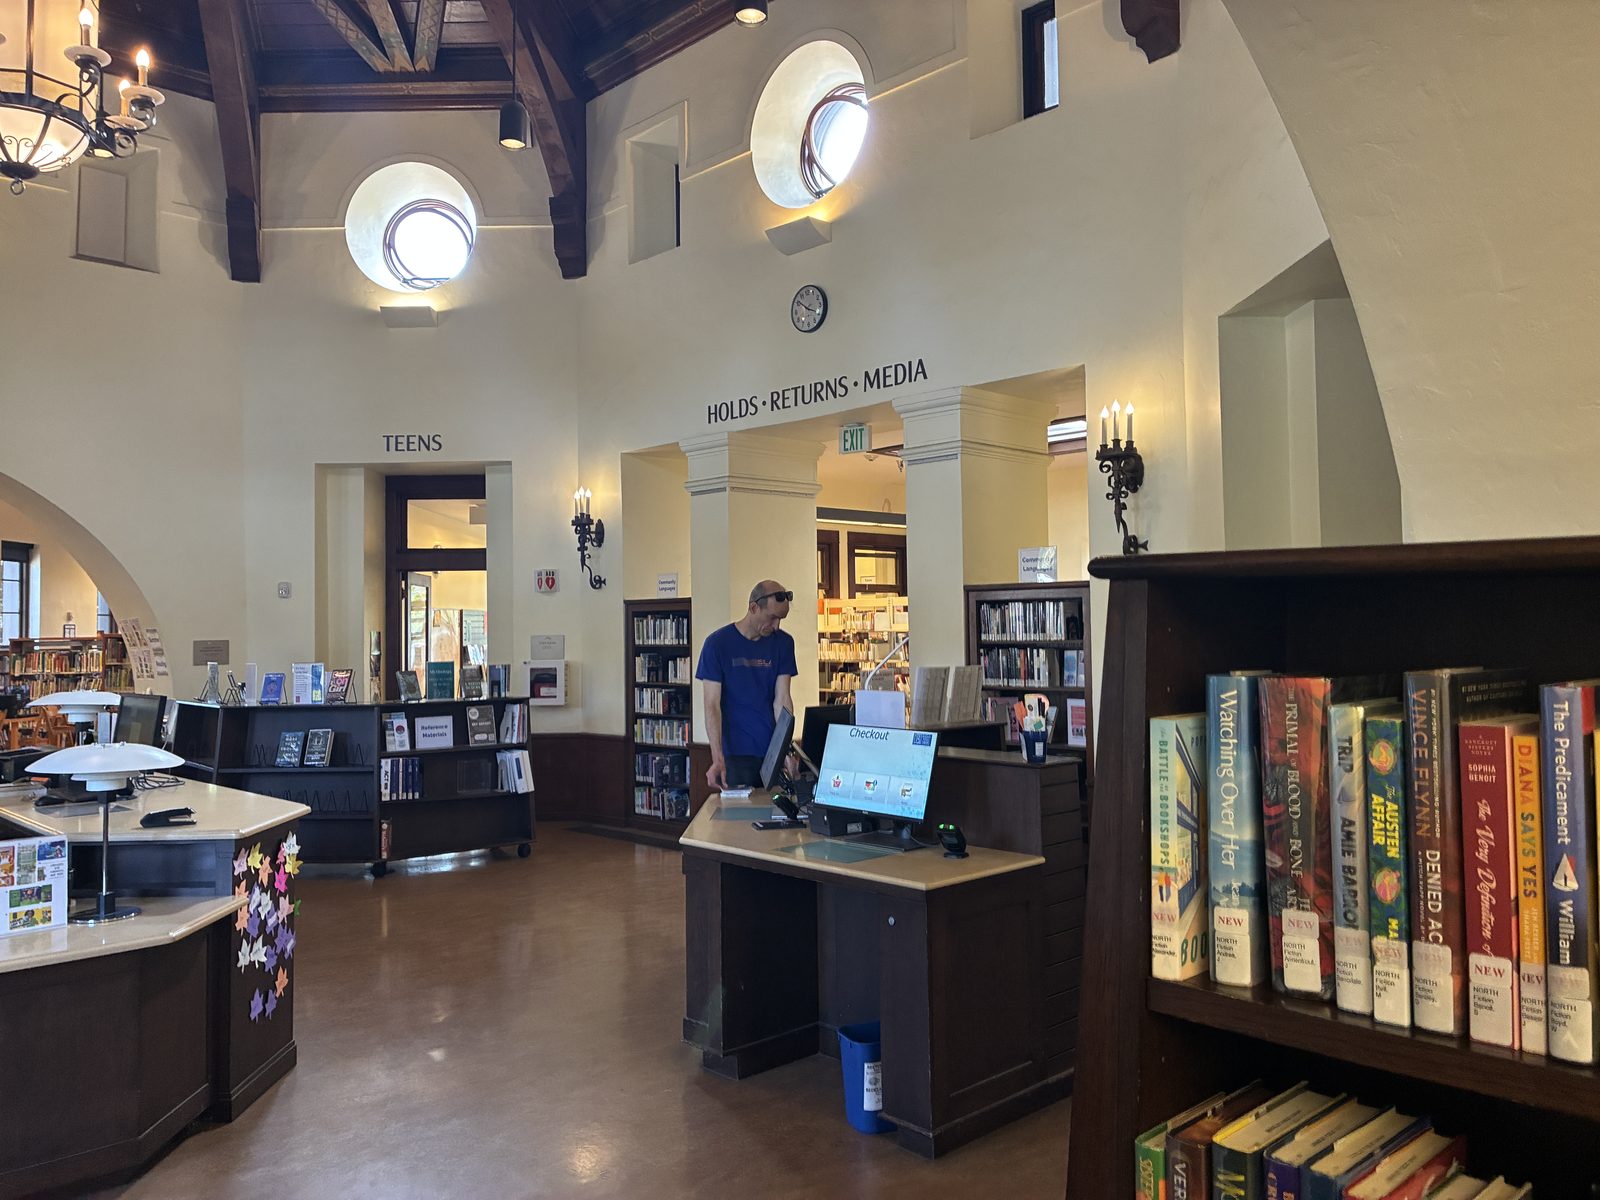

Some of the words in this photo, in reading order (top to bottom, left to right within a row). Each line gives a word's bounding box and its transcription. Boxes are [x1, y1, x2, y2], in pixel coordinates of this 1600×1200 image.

[707, 395, 759, 425] HOLDS
[770, 375, 849, 412] RETURNS
[863, 358, 928, 393] MEDIA
[382, 434, 443, 452] TEENS
[843, 427, 865, 452] EXIT
[422, 731, 447, 739] Materials
[849, 727, 890, 741] Checkout
[1216, 689, 1239, 779] Watching
[1285, 703, 1299, 757] PRIMAL
[1412, 689, 1429, 760] VINCE
[1553, 701, 1570, 733] The
[1158, 740, 1169, 782] BATTLE
[1337, 735, 1354, 774] TRIP
[1468, 763, 1496, 773] SOPHIA
[1517, 743, 1535, 806] DIANA
[1287, 769, 1302, 820] BLOOD
[1468, 774, 1497, 784] BENOIT
[1554, 736, 1571, 846] Predicament
[1220, 782, 1240, 831] Over
[1371, 793, 1386, 847] AFFAIR
[1414, 767, 1431, 837] FLYNN
[1159, 794, 1170, 865] BOOKSHOPS
[1340, 816, 1357, 859] AMIE
[1385, 800, 1400, 860] AUSTEN
[1476, 824, 1496, 865] Very
[1520, 811, 1536, 858] SAYS
[1220, 833, 1240, 871] Her
[1289, 838, 1304, 879] BONE
[1425, 849, 1443, 914] DENIED
[1522, 864, 1537, 899] YES
[1153, 912, 1177, 923] NEW
[1218, 915, 1244, 927] NEW
[1288, 918, 1315, 929] NEW
[1476, 867, 1497, 940] Definition
[1216, 937, 1238, 945] NORTH
[1284, 942, 1306, 951] NORTH
[1375, 946, 1402, 958] NEW
[1558, 899, 1576, 965] William
[1375, 969, 1400, 979] NORTH
[1474, 963, 1504, 978] NEW
[1473, 986, 1499, 997] NORTH
[1473, 994, 1494, 1004] Fiction
